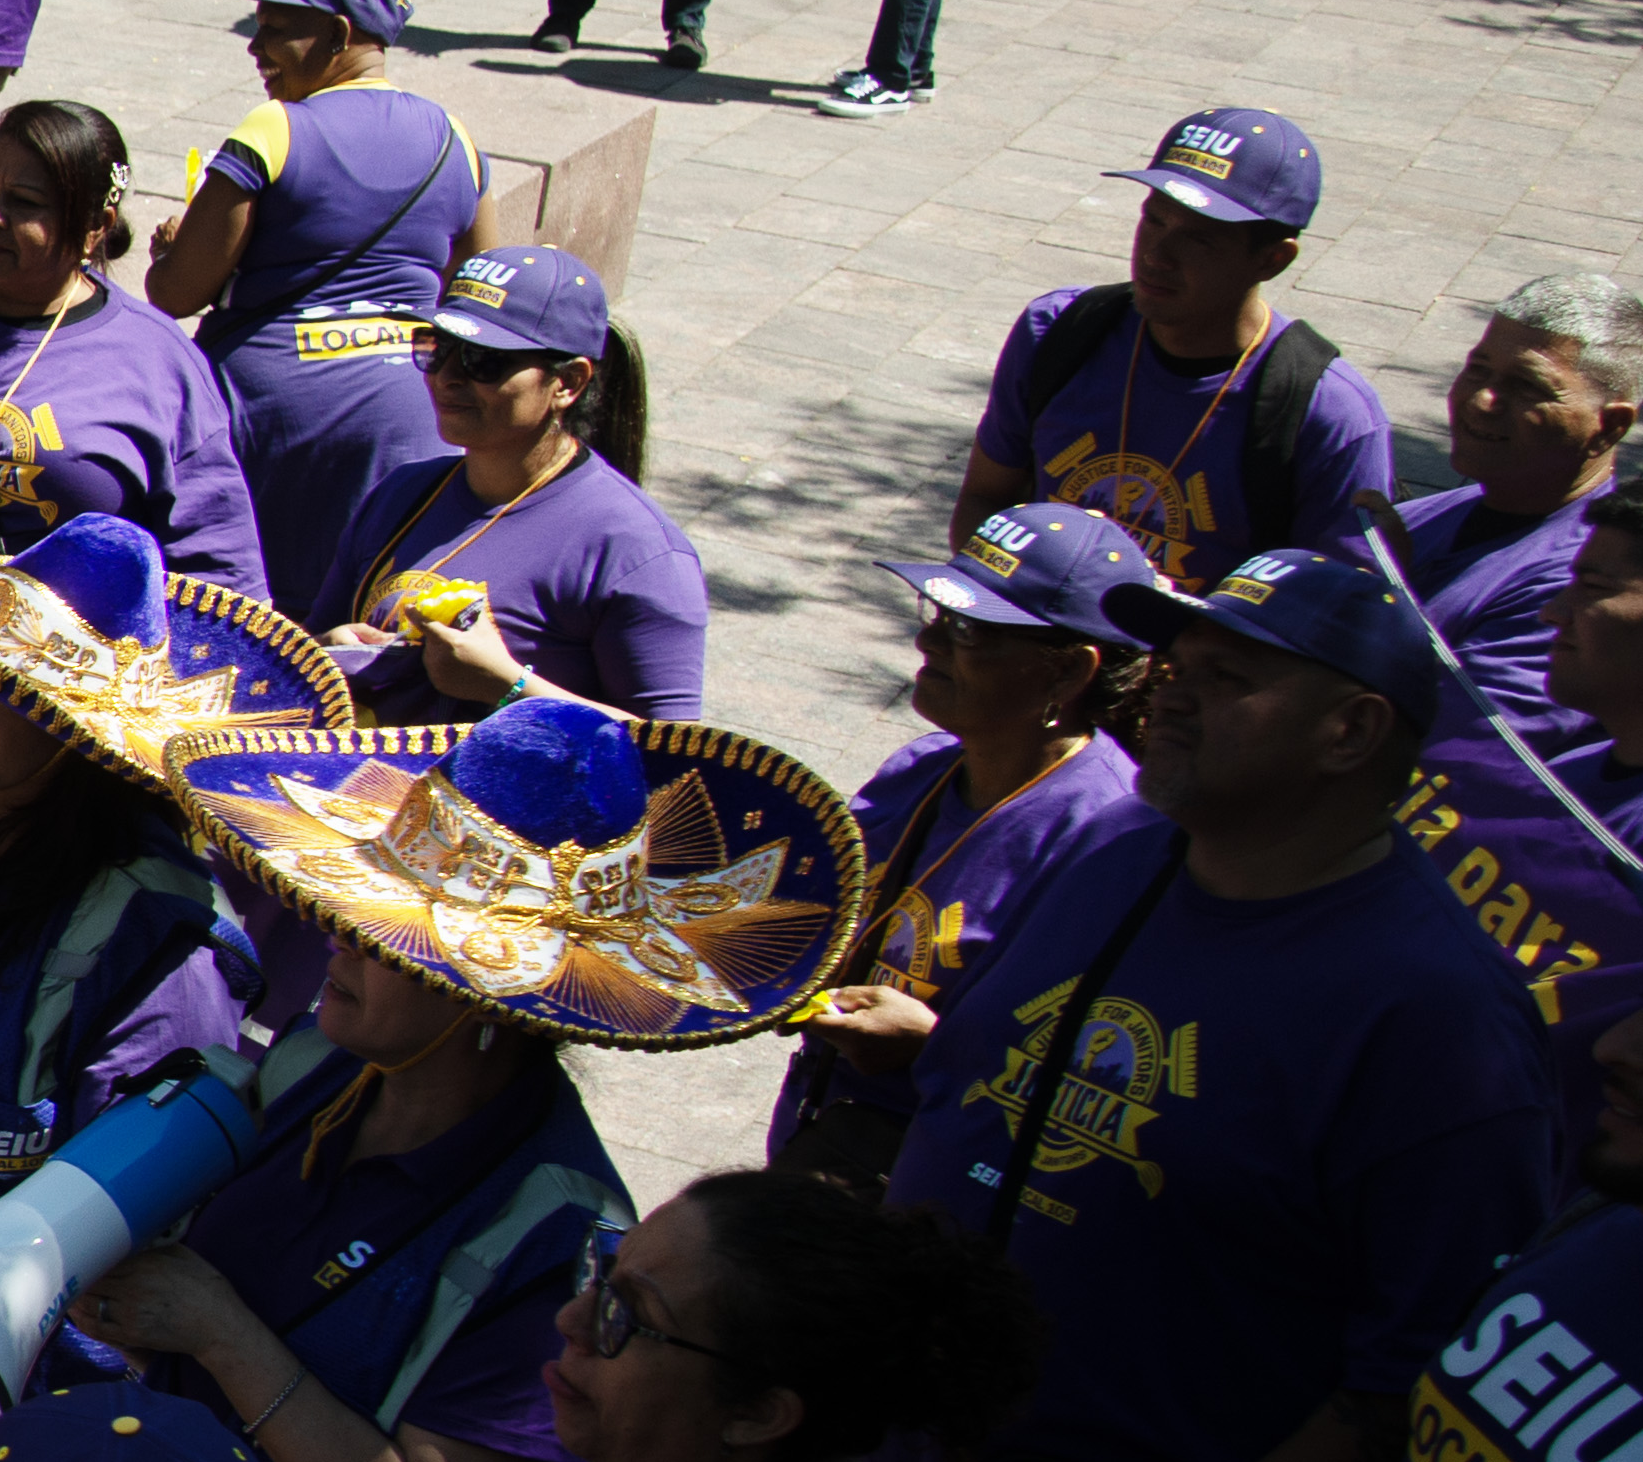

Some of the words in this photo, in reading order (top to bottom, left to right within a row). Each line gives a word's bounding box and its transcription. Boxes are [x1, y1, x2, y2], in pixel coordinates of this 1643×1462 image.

[1174, 123, 1243, 157] SEIU
[456, 257, 518, 287] SEIU
[974, 513, 1039, 552] SEIU
[1099, 1005, 1124, 1026] FOR
[1125, 1016, 1156, 1097] JANITORS
